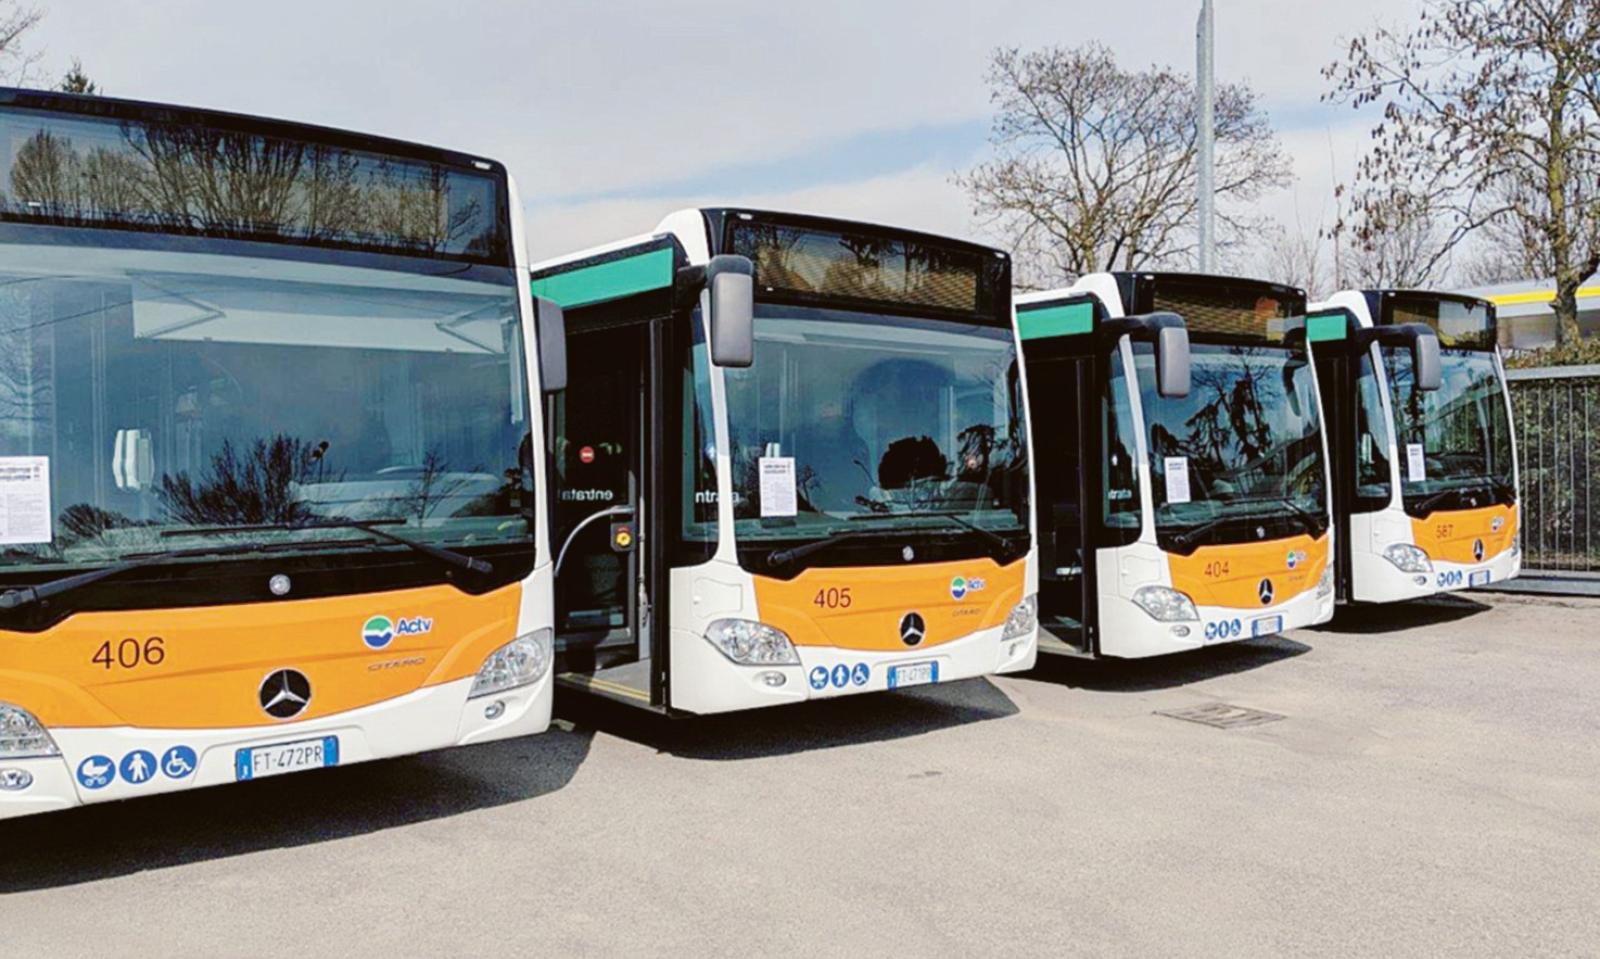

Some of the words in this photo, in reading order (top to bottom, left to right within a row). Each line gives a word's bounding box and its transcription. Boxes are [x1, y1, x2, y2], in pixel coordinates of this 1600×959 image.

[1204, 560, 1230, 578] 404
[813, 586, 852, 609] 405
[396, 616, 433, 636] Actv
[92, 636, 165, 669] 406
